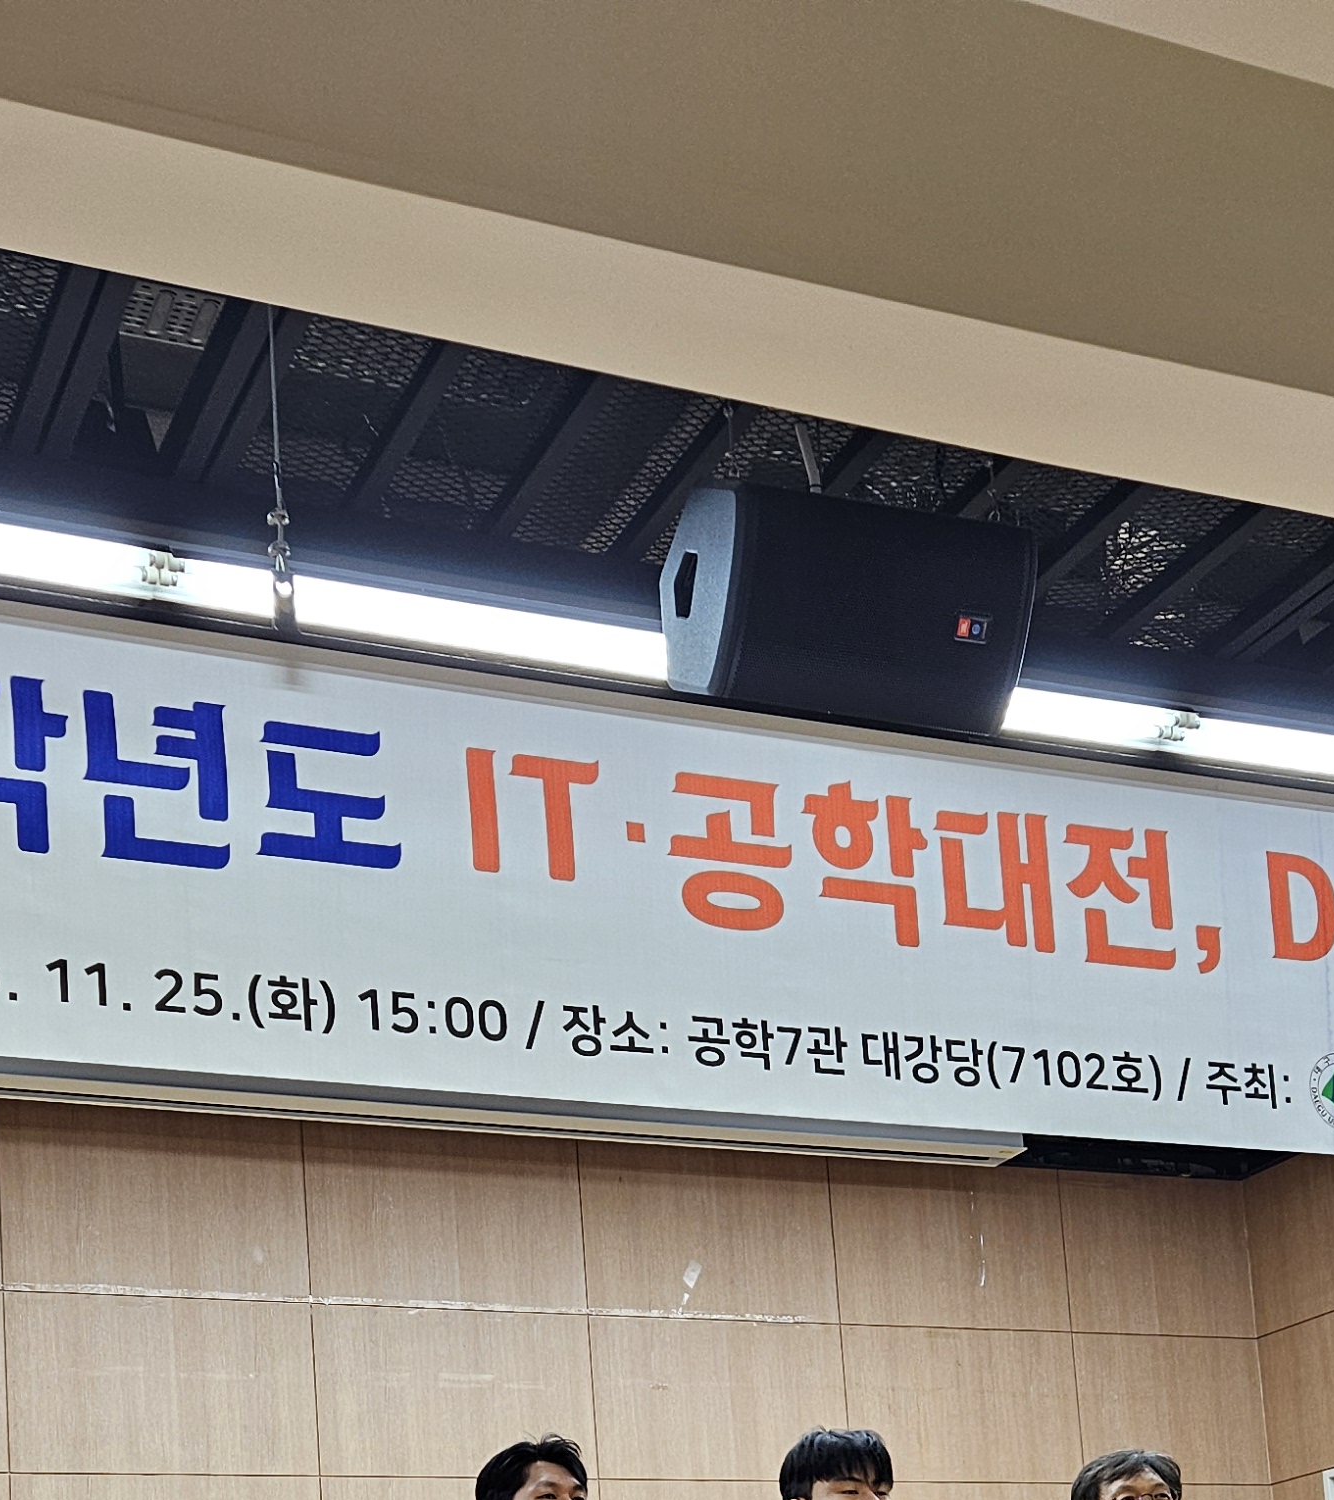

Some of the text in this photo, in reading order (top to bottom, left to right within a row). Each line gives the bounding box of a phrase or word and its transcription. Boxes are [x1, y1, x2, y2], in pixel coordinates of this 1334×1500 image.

[467, 747, 1220, 973] IT·공학대전,
[46, 958, 132, 1012] 11.
[154, 968, 336, 1035] 25.(화)
[357, 988, 508, 1042] 15:00
[525, 1000, 545, 1050] /
[562, 1004, 669, 1057] 장소:
[687, 1015, 848, 1076] 공학7관
[861, 1032, 1162, 1102] 대강당(7102호)
[1177, 1057, 1191, 1102] /
[1205, 1061, 1292, 1110] 주최:
